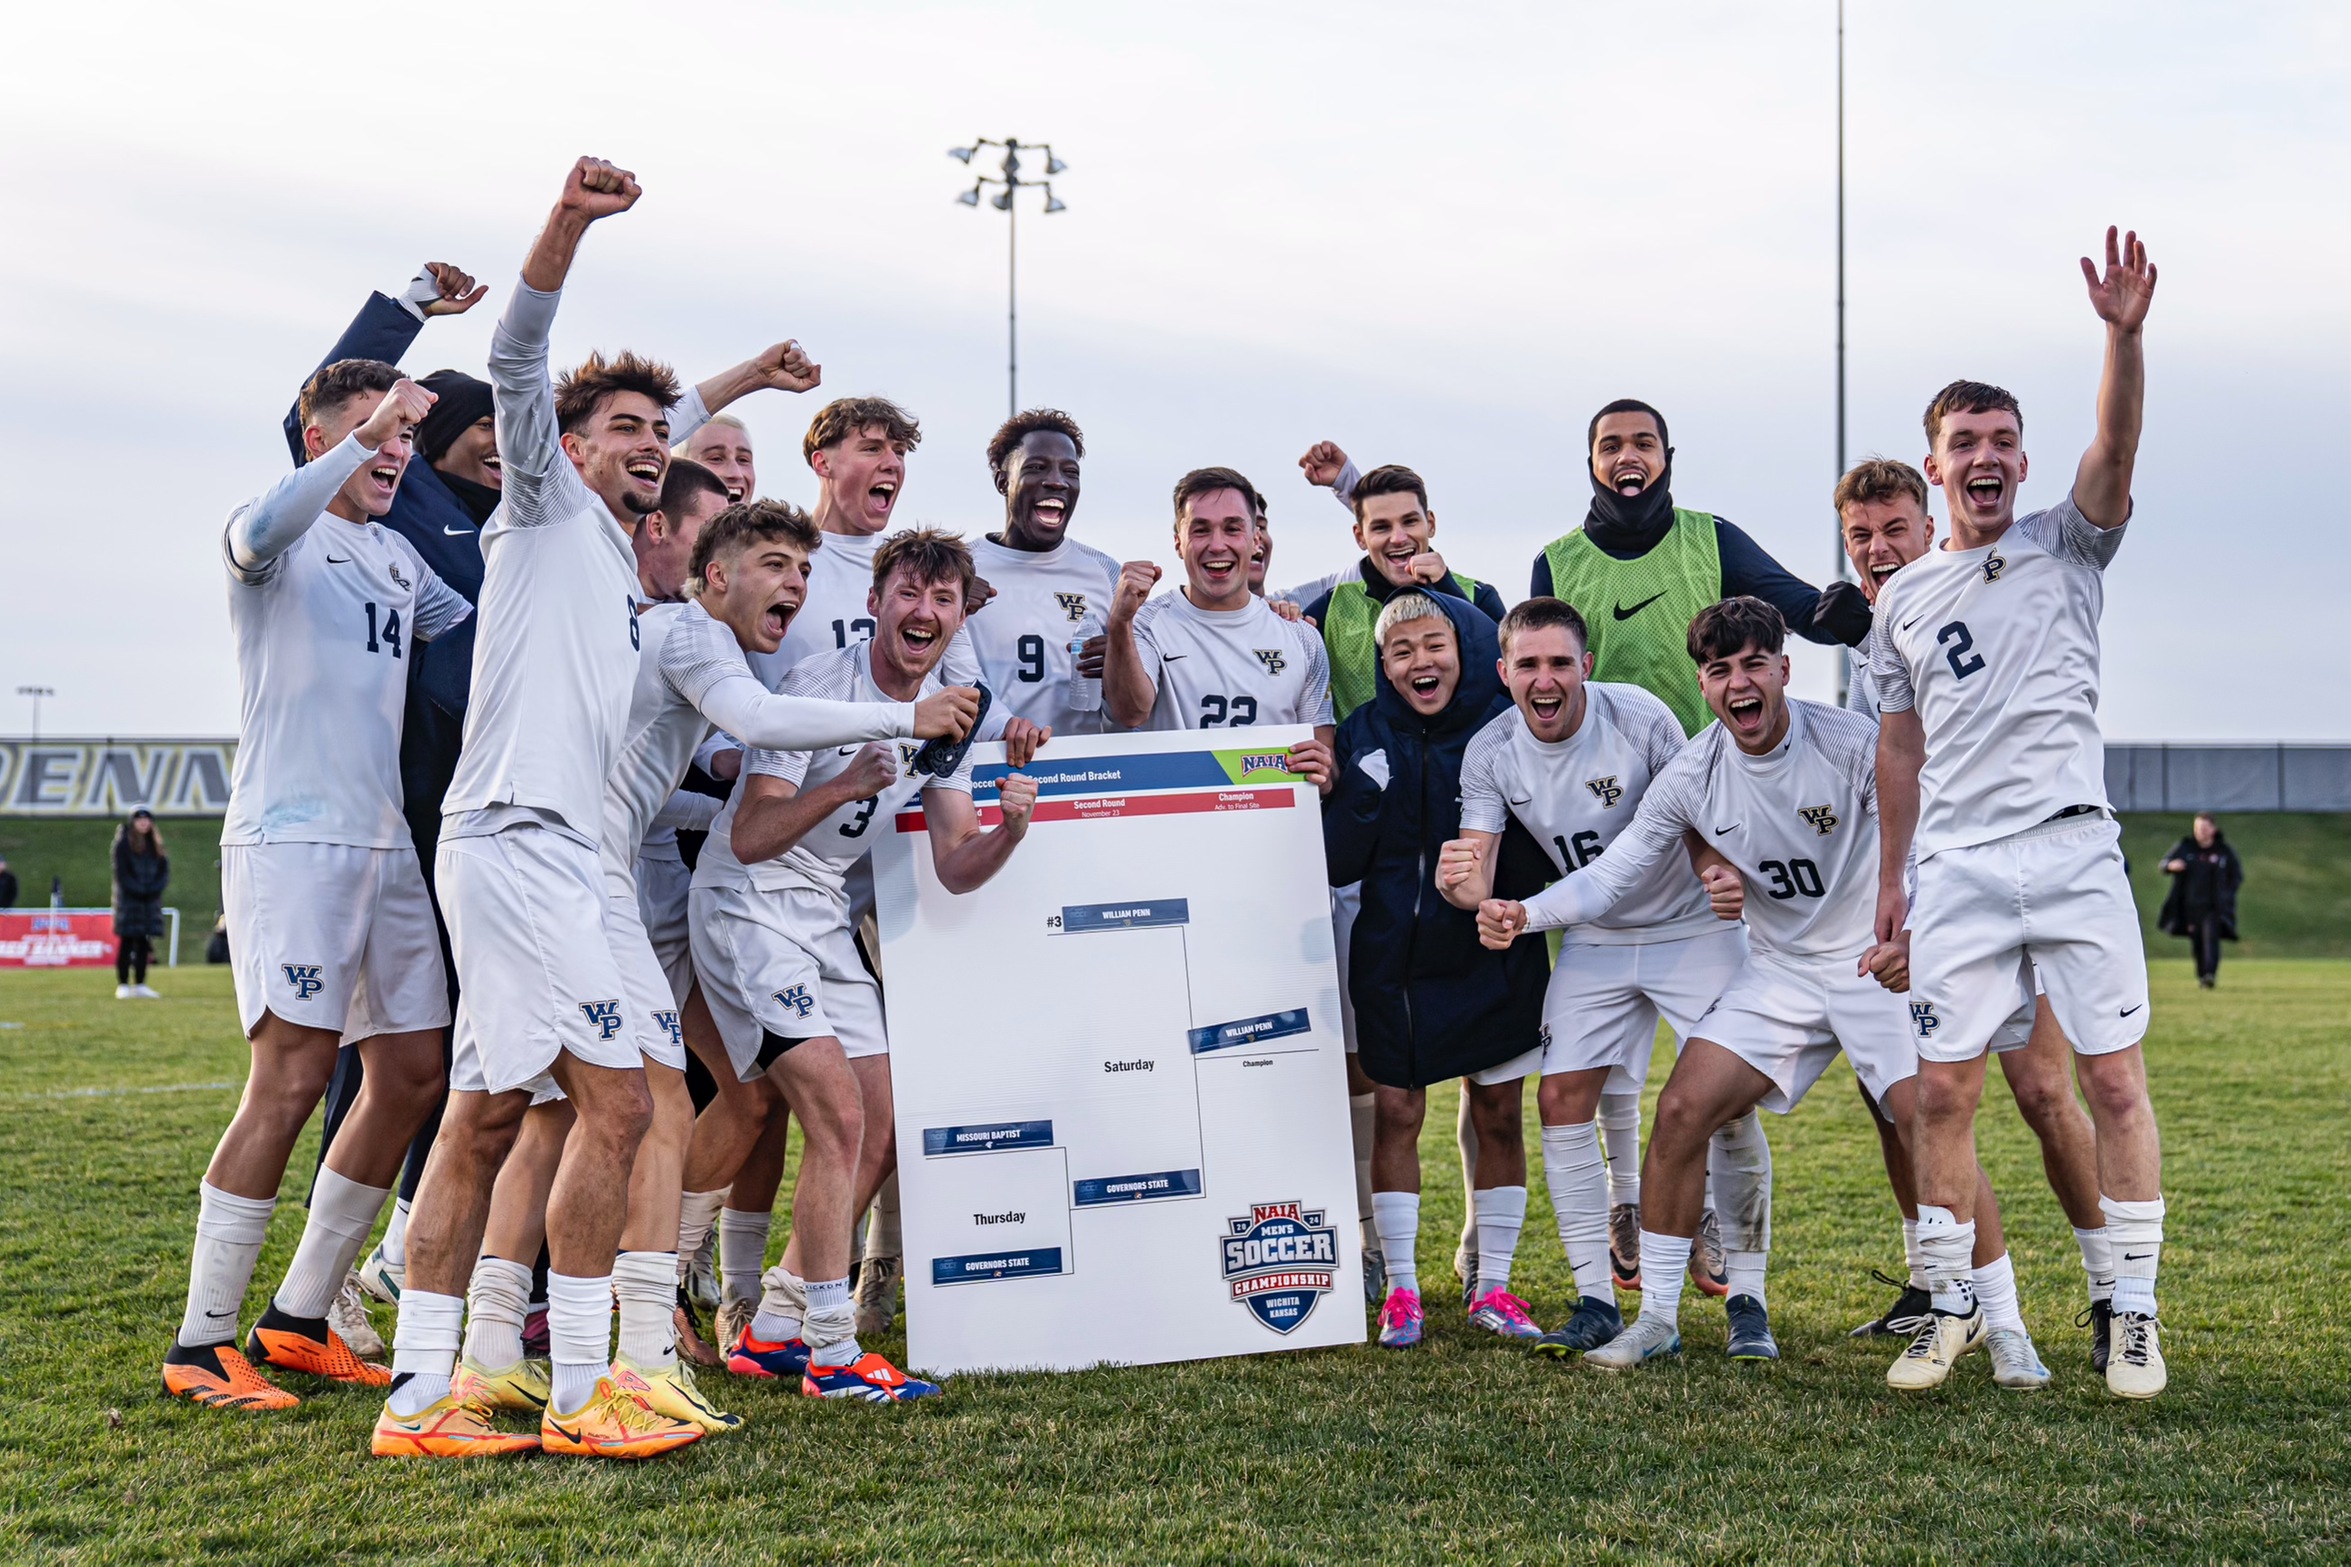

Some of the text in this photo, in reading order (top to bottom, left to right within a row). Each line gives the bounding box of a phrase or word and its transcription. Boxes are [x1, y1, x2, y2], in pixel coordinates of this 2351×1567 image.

[1980, 547, 2007, 584] P
[1054, 592, 1088, 622] WP
[365, 602, 401, 659] 14
[1017, 634, 1044, 683] 9
[1937, 621, 1986, 680] 2
[1252, 649, 1288, 676] WP
[1200, 694, 1257, 729] 22
[1241, 753, 1289, 778] NAIA
[0, 745, 236, 810] ENN
[972, 779, 996, 789] occer
[1060, 771, 1087, 783] Round
[1088, 769, 1121, 781] Bracket
[1218, 792, 1254, 802] Champion
[1585, 775, 1624, 809] WP
[1074, 798, 1126, 810] Second Round
[1081, 809, 1120, 819] November 23
[839, 794, 879, 838] 3
[1797, 804, 1839, 836] WP
[1553, 830, 1604, 873] 16
[1758, 858, 1826, 899] 30
[1047, 915, 1062, 928] #3
[1102, 908, 1151, 919] WILLIAM PENN
[281, 963, 325, 1000] WP
[770, 982, 816, 1020] WP
[578, 999, 624, 1042] WP
[1225, 1024, 1254, 1037] WILLIAM
[1254, 1021, 1273, 1032] PENN
[1909, 1001, 1941, 1038] WP
[1104, 1059, 1155, 1073] Saturday
[1242, 1059, 1273, 1068] Champion
[956, 1131, 990, 1142] MISSOURI
[991, 1129, 1021, 1139] BAPTIST
[1106, 1181, 1146, 1193] GOVERNORS
[1147, 1179, 1169, 1189] STATE
[973, 1211, 1026, 1225] Thursday
[1253, 1203, 1300, 1226] NAIA
[1309, 1216, 1319, 1224] 24
[1236, 1223, 1247, 1231] 20
[1261, 1224, 1294, 1236] MEN'S
[965, 1259, 1007, 1270] GOVERNORS
[1008, 1257, 1030, 1267] STATE
[1226, 1233, 1334, 1271] SOCCER
[1234, 1274, 1329, 1294] CHAMPIONSHIP
[1265, 1296, 1300, 1308] WICHITA
[1269, 1308, 1298, 1318] KANSAS
